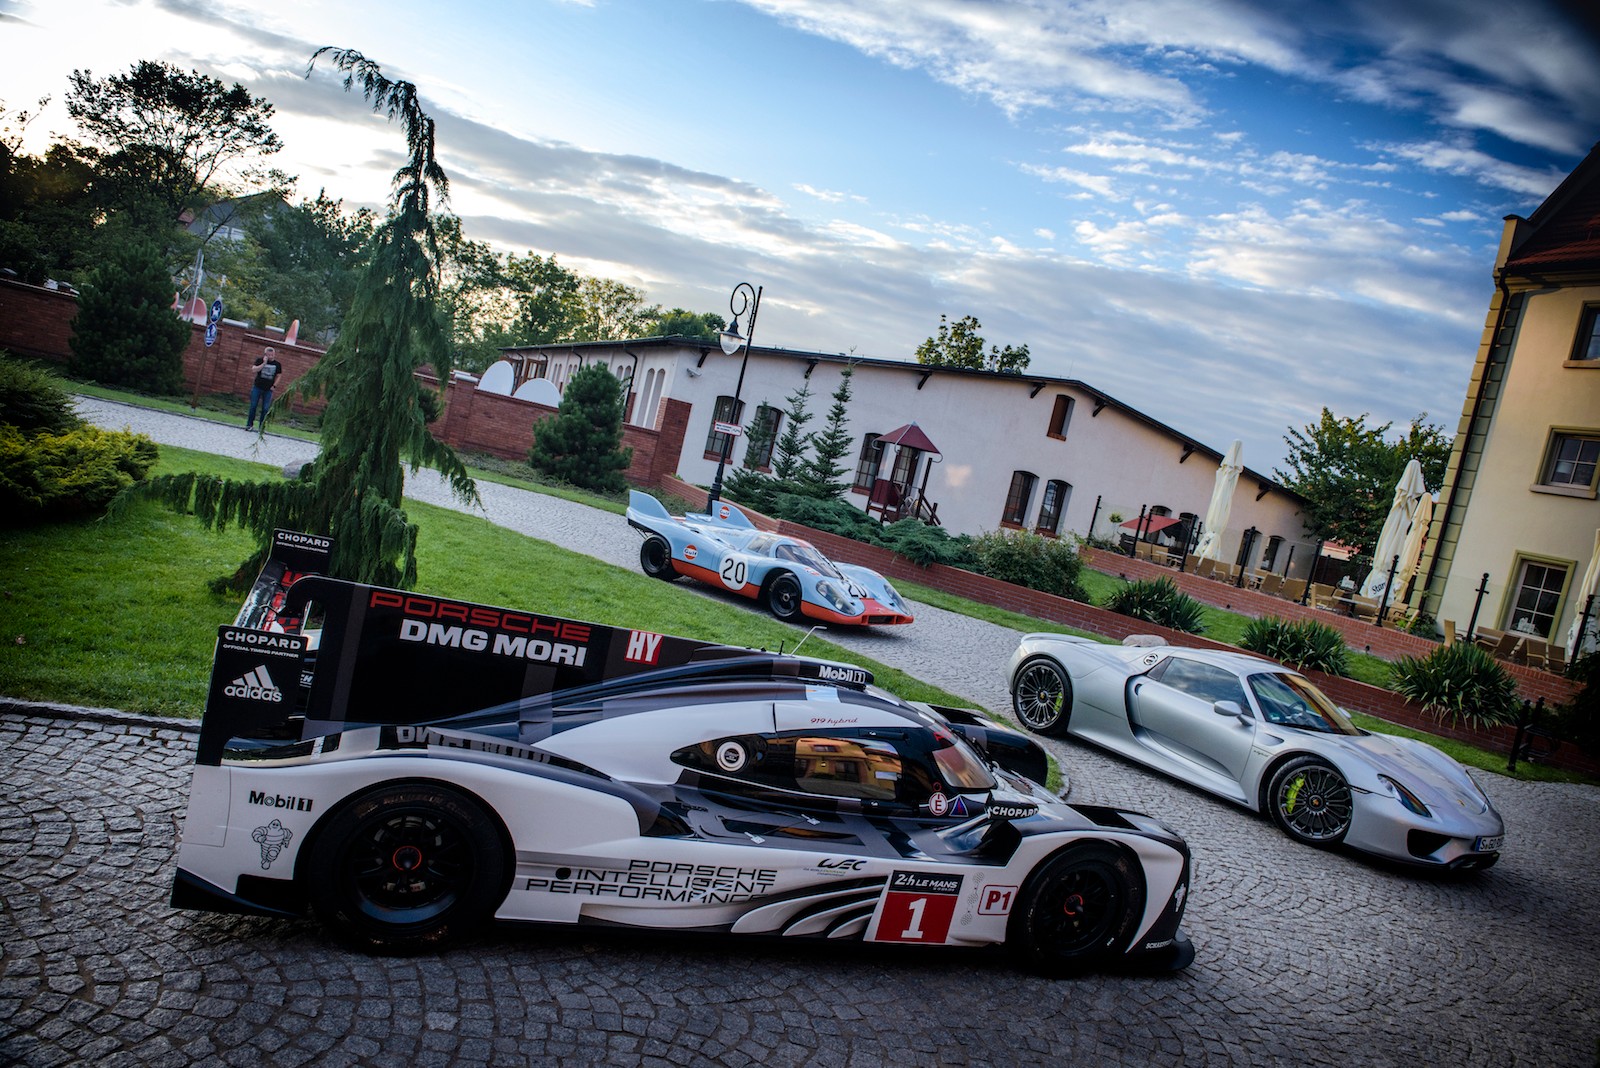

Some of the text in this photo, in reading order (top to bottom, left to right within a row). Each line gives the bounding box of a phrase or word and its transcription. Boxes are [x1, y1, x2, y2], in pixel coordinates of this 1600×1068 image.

[277, 532, 330, 548] CHOPARD
[684, 549, 698, 557] Gulf
[722, 558, 745, 584] 20
[370, 592, 591, 642] PORSCHE
[224, 631, 302, 650] CHOPARD
[400, 619, 587, 667] DMG MORI
[625, 630, 663, 662] HY
[223, 643, 299, 658] OFFICIAL TIMING PARTNER
[819, 665, 854, 682] Mobil
[224, 685, 282, 702] adidas
[827, 717, 858, 726] hybrid
[249, 790, 295, 810] Mobil
[628, 860, 777, 881] PORSCHE
[817, 858, 868, 871] WEC
[577, 869, 774, 893] INTELLIGENT
[915, 879, 929, 887] LE
[929, 880, 958, 889] MANS
[985, 890, 1011, 911] P1
[901, 898, 927, 939] 1
